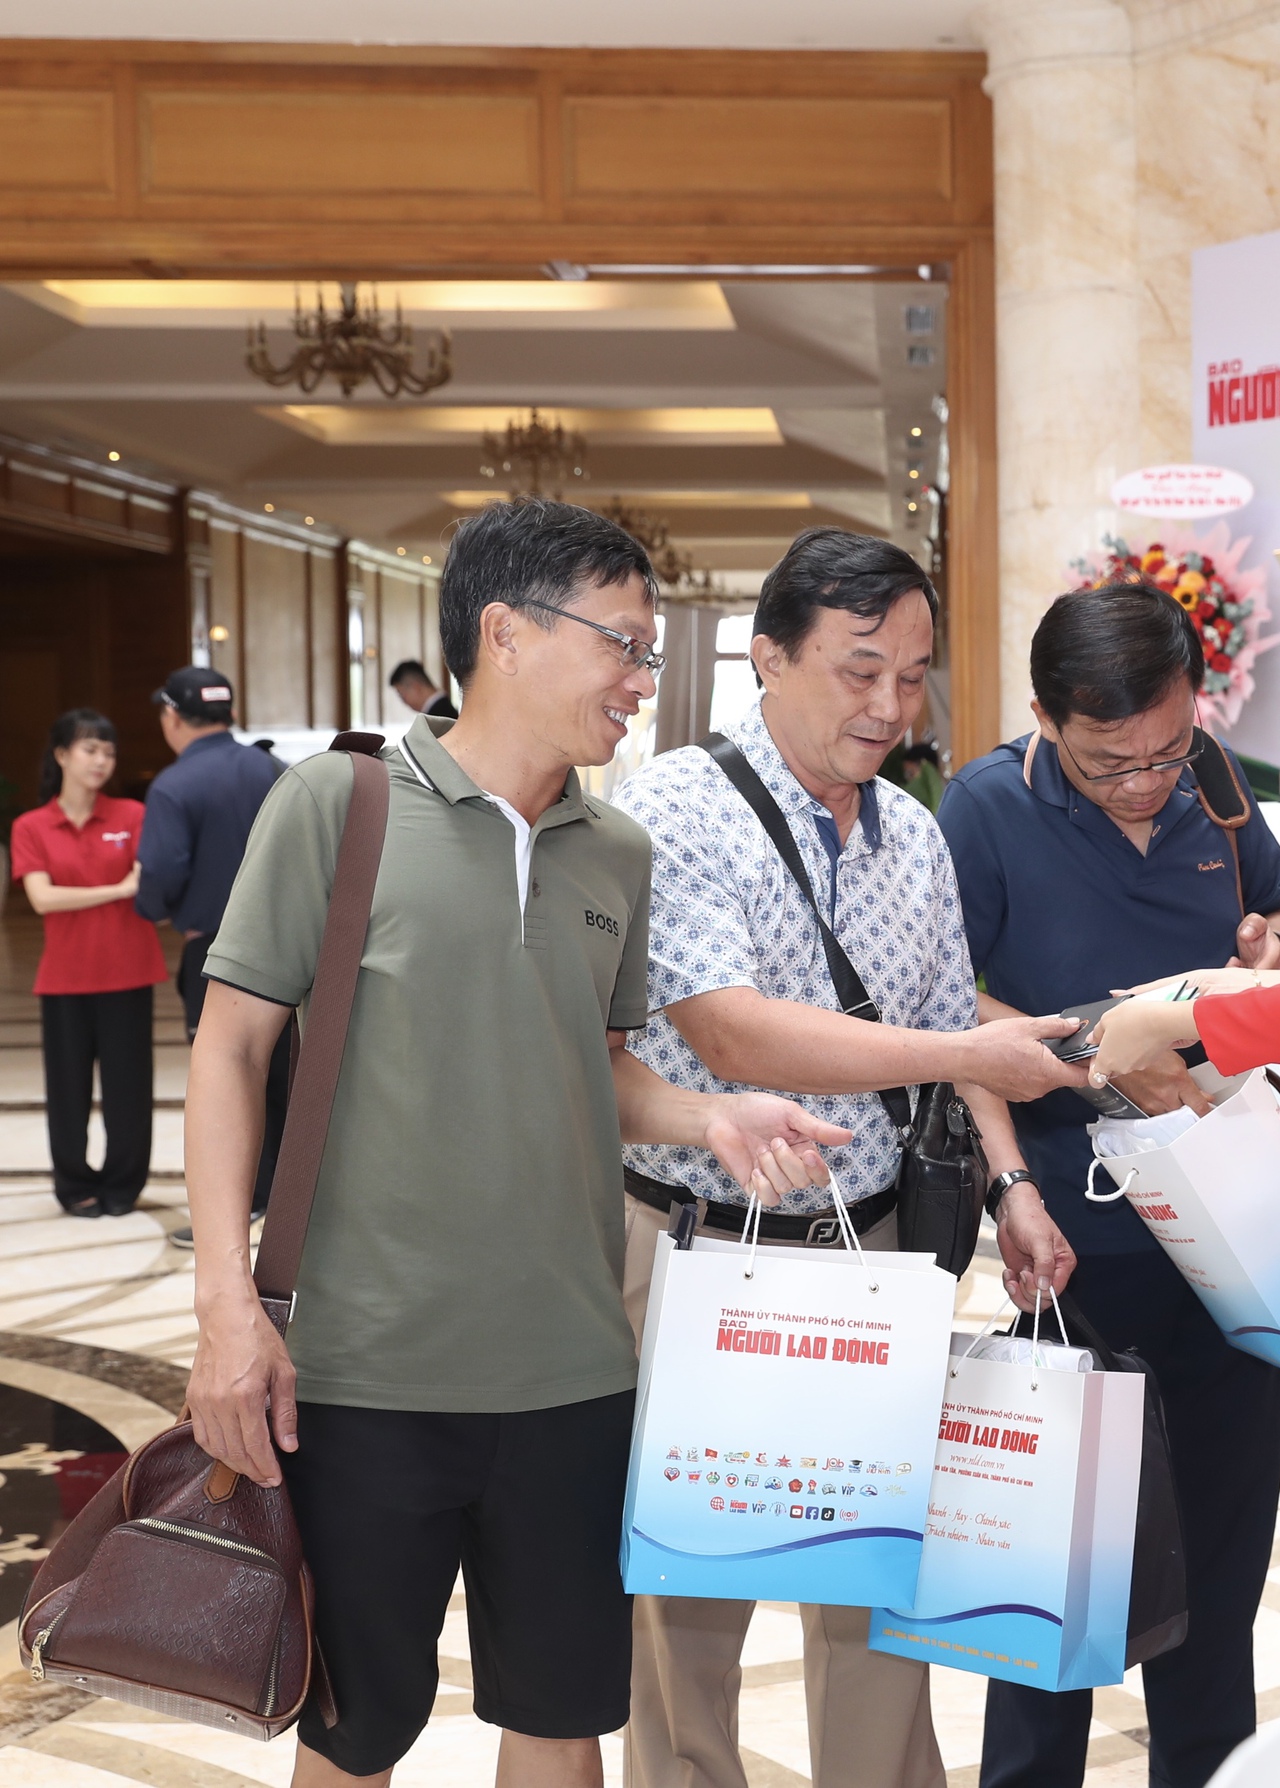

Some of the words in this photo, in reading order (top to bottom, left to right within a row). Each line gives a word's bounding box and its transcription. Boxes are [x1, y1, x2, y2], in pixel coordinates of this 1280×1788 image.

[584, 909, 619, 937] BOSS
[721, 1308, 754, 1319] THÀNH
[756, 1309, 770, 1320] ỦY
[772, 1312, 806, 1324] THÀNH
[808, 1315, 829, 1326] PHỐ
[831, 1317, 845, 1327] HỒ
[847, 1319, 863, 1329] CHÍ
[865, 1321, 892, 1331] MINH
[716, 1328, 782, 1356] NGƯỜI
[786, 1334, 827, 1360] LAO
[832, 1337, 890, 1365] ĐỘNG
[956, 1403, 966, 1412] ỦY
[967, 1406, 989, 1416] THÀNH
[990, 1409, 1004, 1418] PHỐ
[1013, 1413, 1024, 1422] CHÍ
[1025, 1415, 1043, 1424] MINH
[938, 1419, 972, 1444] GƯỜI
[972, 1425, 999, 1448] LAO
[1000, 1429, 1039, 1455] ĐỘNG
[950, 1454, 1005, 1470] www.nld.com.vn
[975, 1512, 997, 1527] Chính
